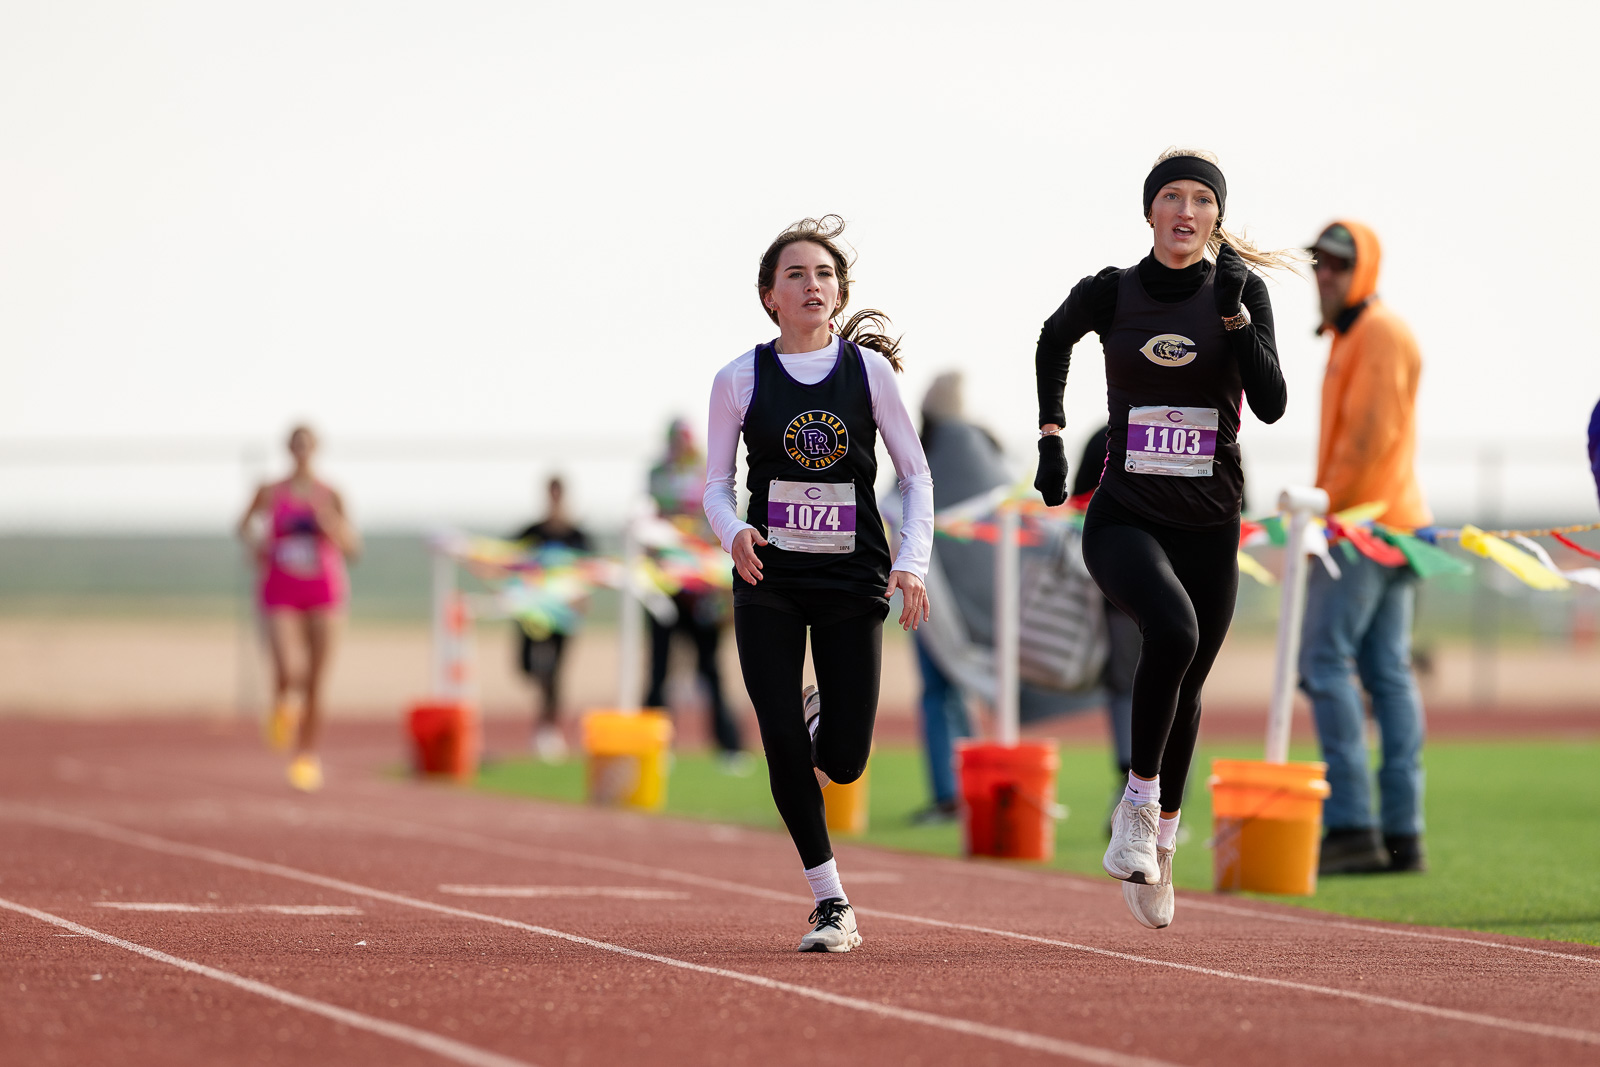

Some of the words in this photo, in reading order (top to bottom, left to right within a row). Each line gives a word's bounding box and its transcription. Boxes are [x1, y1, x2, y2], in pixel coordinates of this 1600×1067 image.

[786, 413, 814, 439] RIVER
[820, 413, 845, 435] ROAD
[1165, 410, 1184, 423] C
[1143, 427, 1201, 455] 1103
[788, 447, 810, 467] CROSS
[815, 444, 847, 468] COUNTRY
[804, 487, 822, 500] C
[785, 504, 841, 531] 1074
